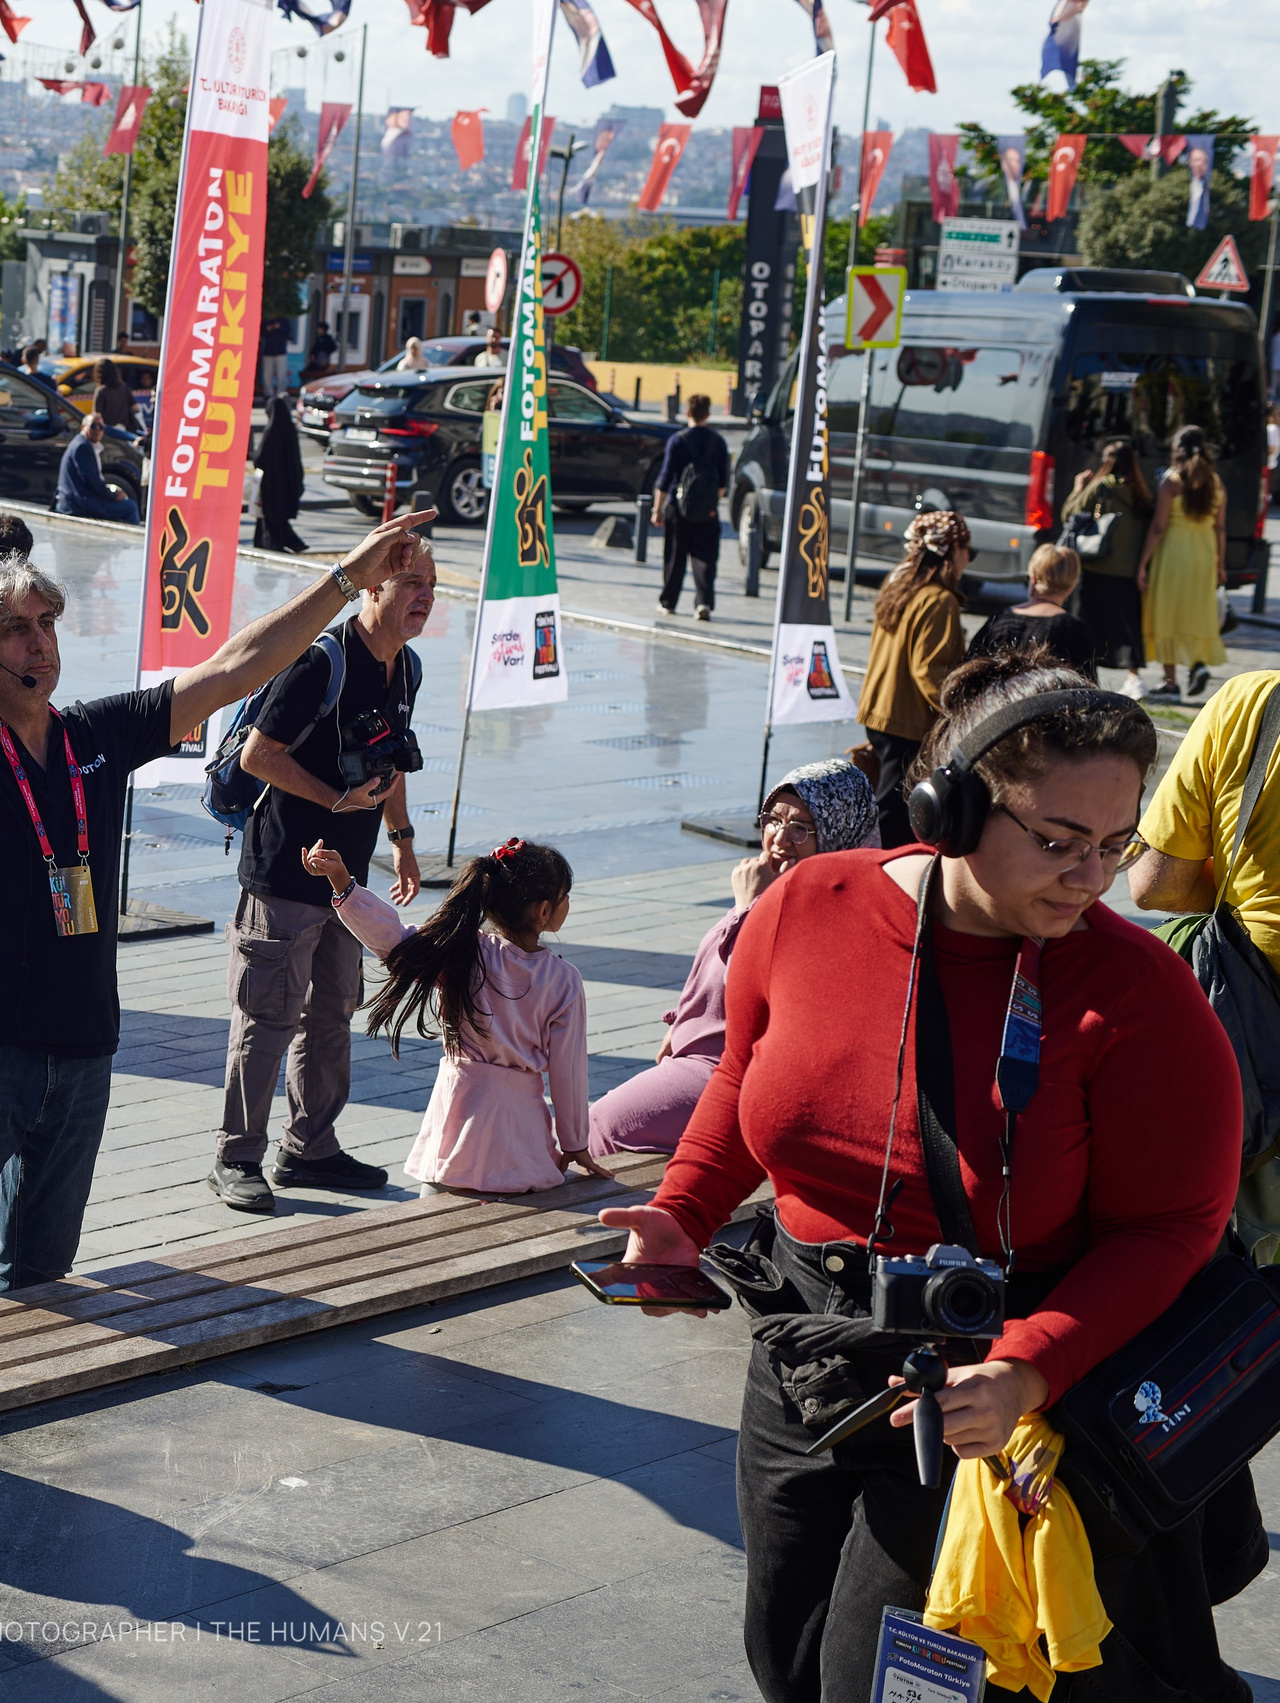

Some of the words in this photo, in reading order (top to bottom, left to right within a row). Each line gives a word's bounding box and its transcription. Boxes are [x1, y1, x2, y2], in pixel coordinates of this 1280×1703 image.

[164, 167, 224, 497] FOTOMARATON
[180, 741, 204, 753] TİVALİ
[49, 876, 68, 894] KÜL
[52, 892, 71, 909] TÜR
[55, 908, 70, 923] YO
[62, 920, 75, 935] LU
[939, 1259, 967, 1267] FUJIFILM
[888, 1626, 898, 1634] T.C.
[898, 1630, 919, 1642] KÜLTÜR
[926, 1640, 947, 1652] TURİZM
[946, 1648, 977, 1662] BAKANLIĞI
[899, 1656, 943, 1678] FotoMaraton
[943, 1673, 971, 1688] Türkiye
